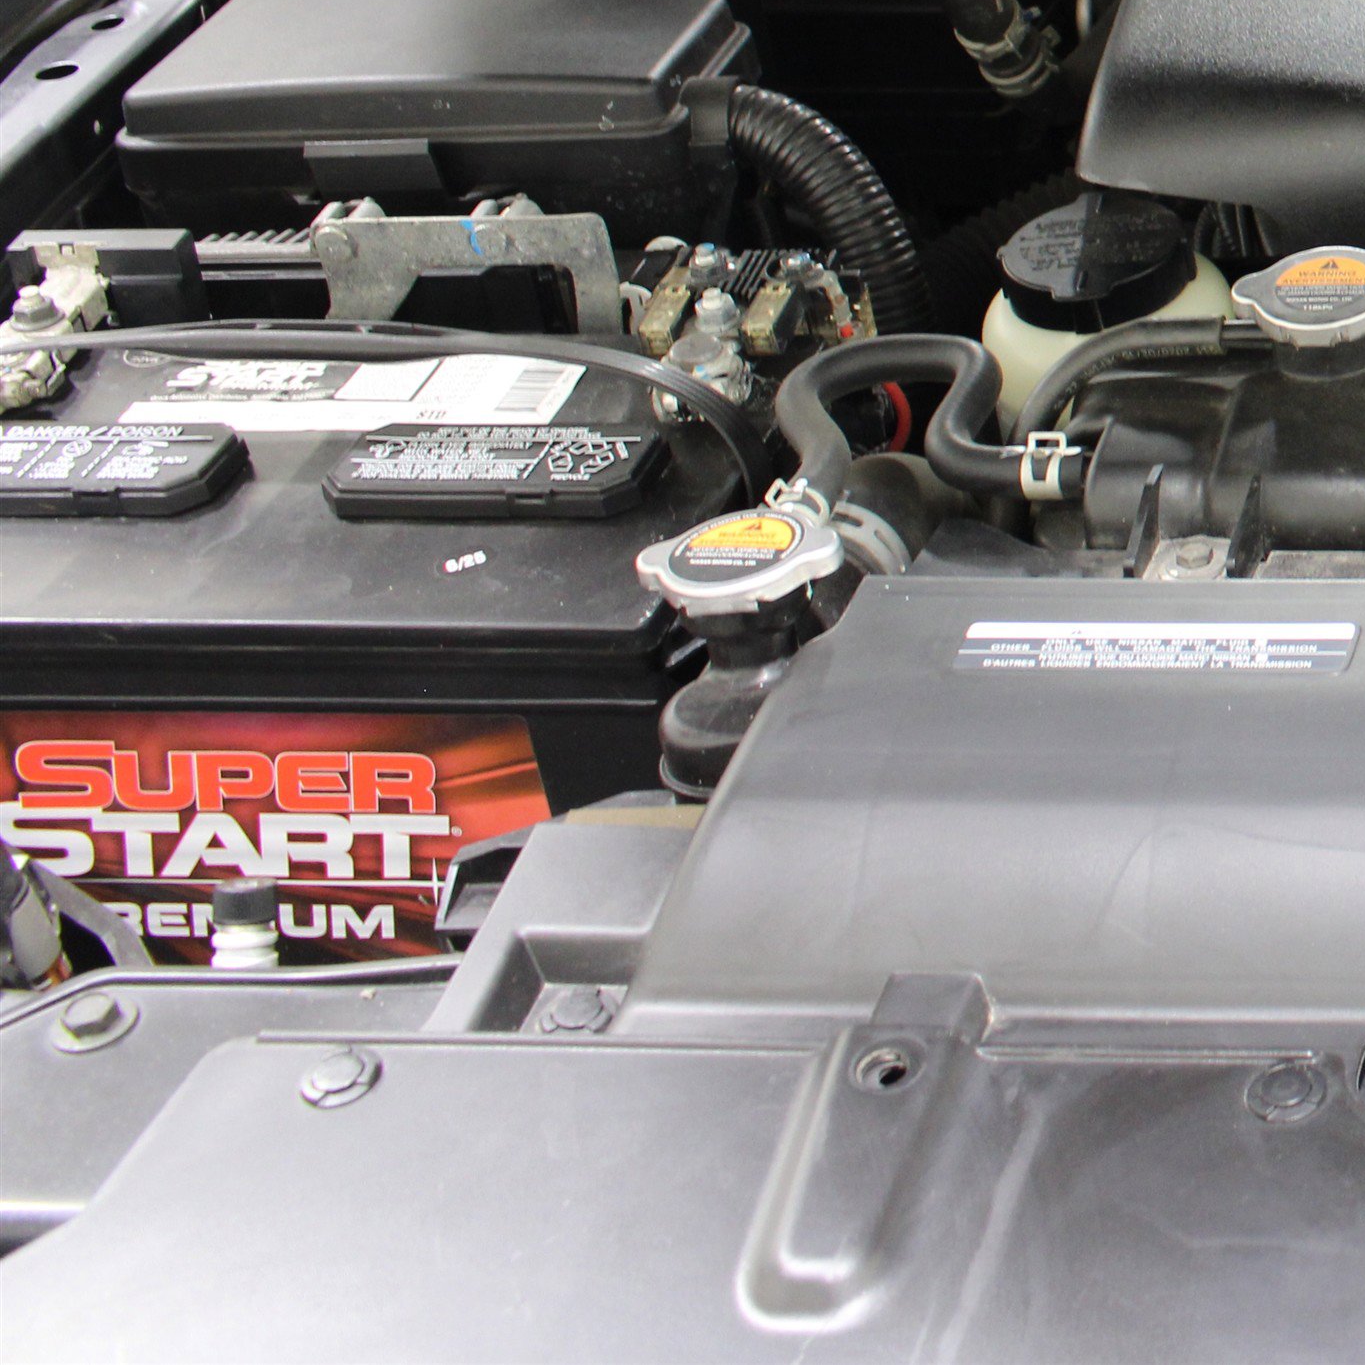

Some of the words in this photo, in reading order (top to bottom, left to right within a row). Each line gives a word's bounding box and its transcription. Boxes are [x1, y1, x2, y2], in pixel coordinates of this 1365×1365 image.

[7, 426, 91, 438] DANGER
[107, 426, 184, 438] POISON
[990, 643, 1031, 652] OTHER
[1041, 644, 1082, 652] FLUIDS
[1093, 644, 1120, 652] WILL
[1133, 644, 1182, 652] DAMAGE
[1194, 644, 1217, 652] THE
[1229, 644, 1318, 653] TRANSMISSION
[1230, 660, 1312, 668] TRANSMISSION
[15, 740, 437, 814] SUPER
[0, 801, 450, 879] START
[102, 901, 396, 940] REUM
